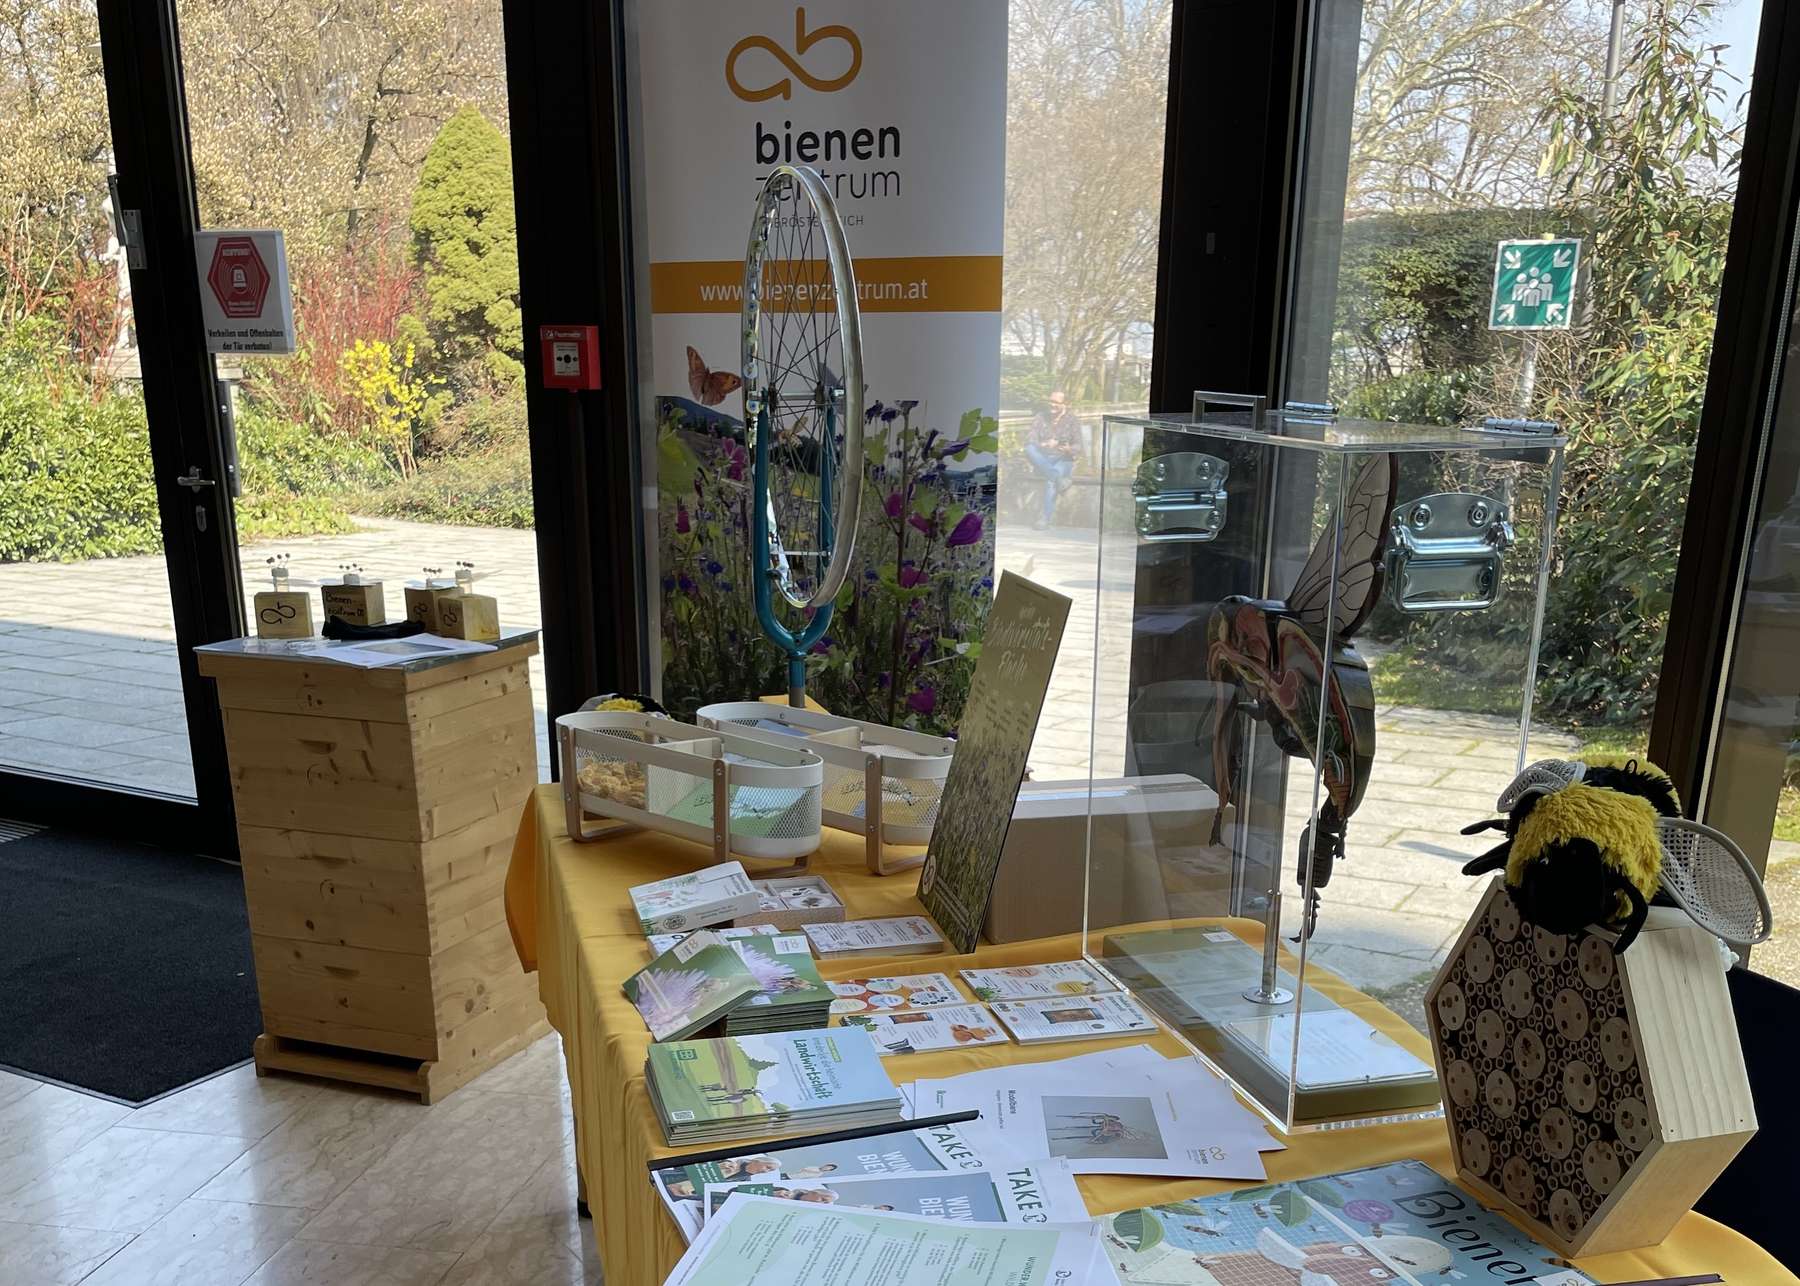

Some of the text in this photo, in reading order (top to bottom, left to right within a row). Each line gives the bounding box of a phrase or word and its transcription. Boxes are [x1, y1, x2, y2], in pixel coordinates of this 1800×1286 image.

[755, 120, 900, 165] bienen
[222, 341, 232, 350] der
[237, 328, 249, 337] und
[793, 1039, 833, 1100] Landwirtschaft
[928, 1124, 974, 1160] TAKE
[1007, 1167, 1044, 1211] TAKE
